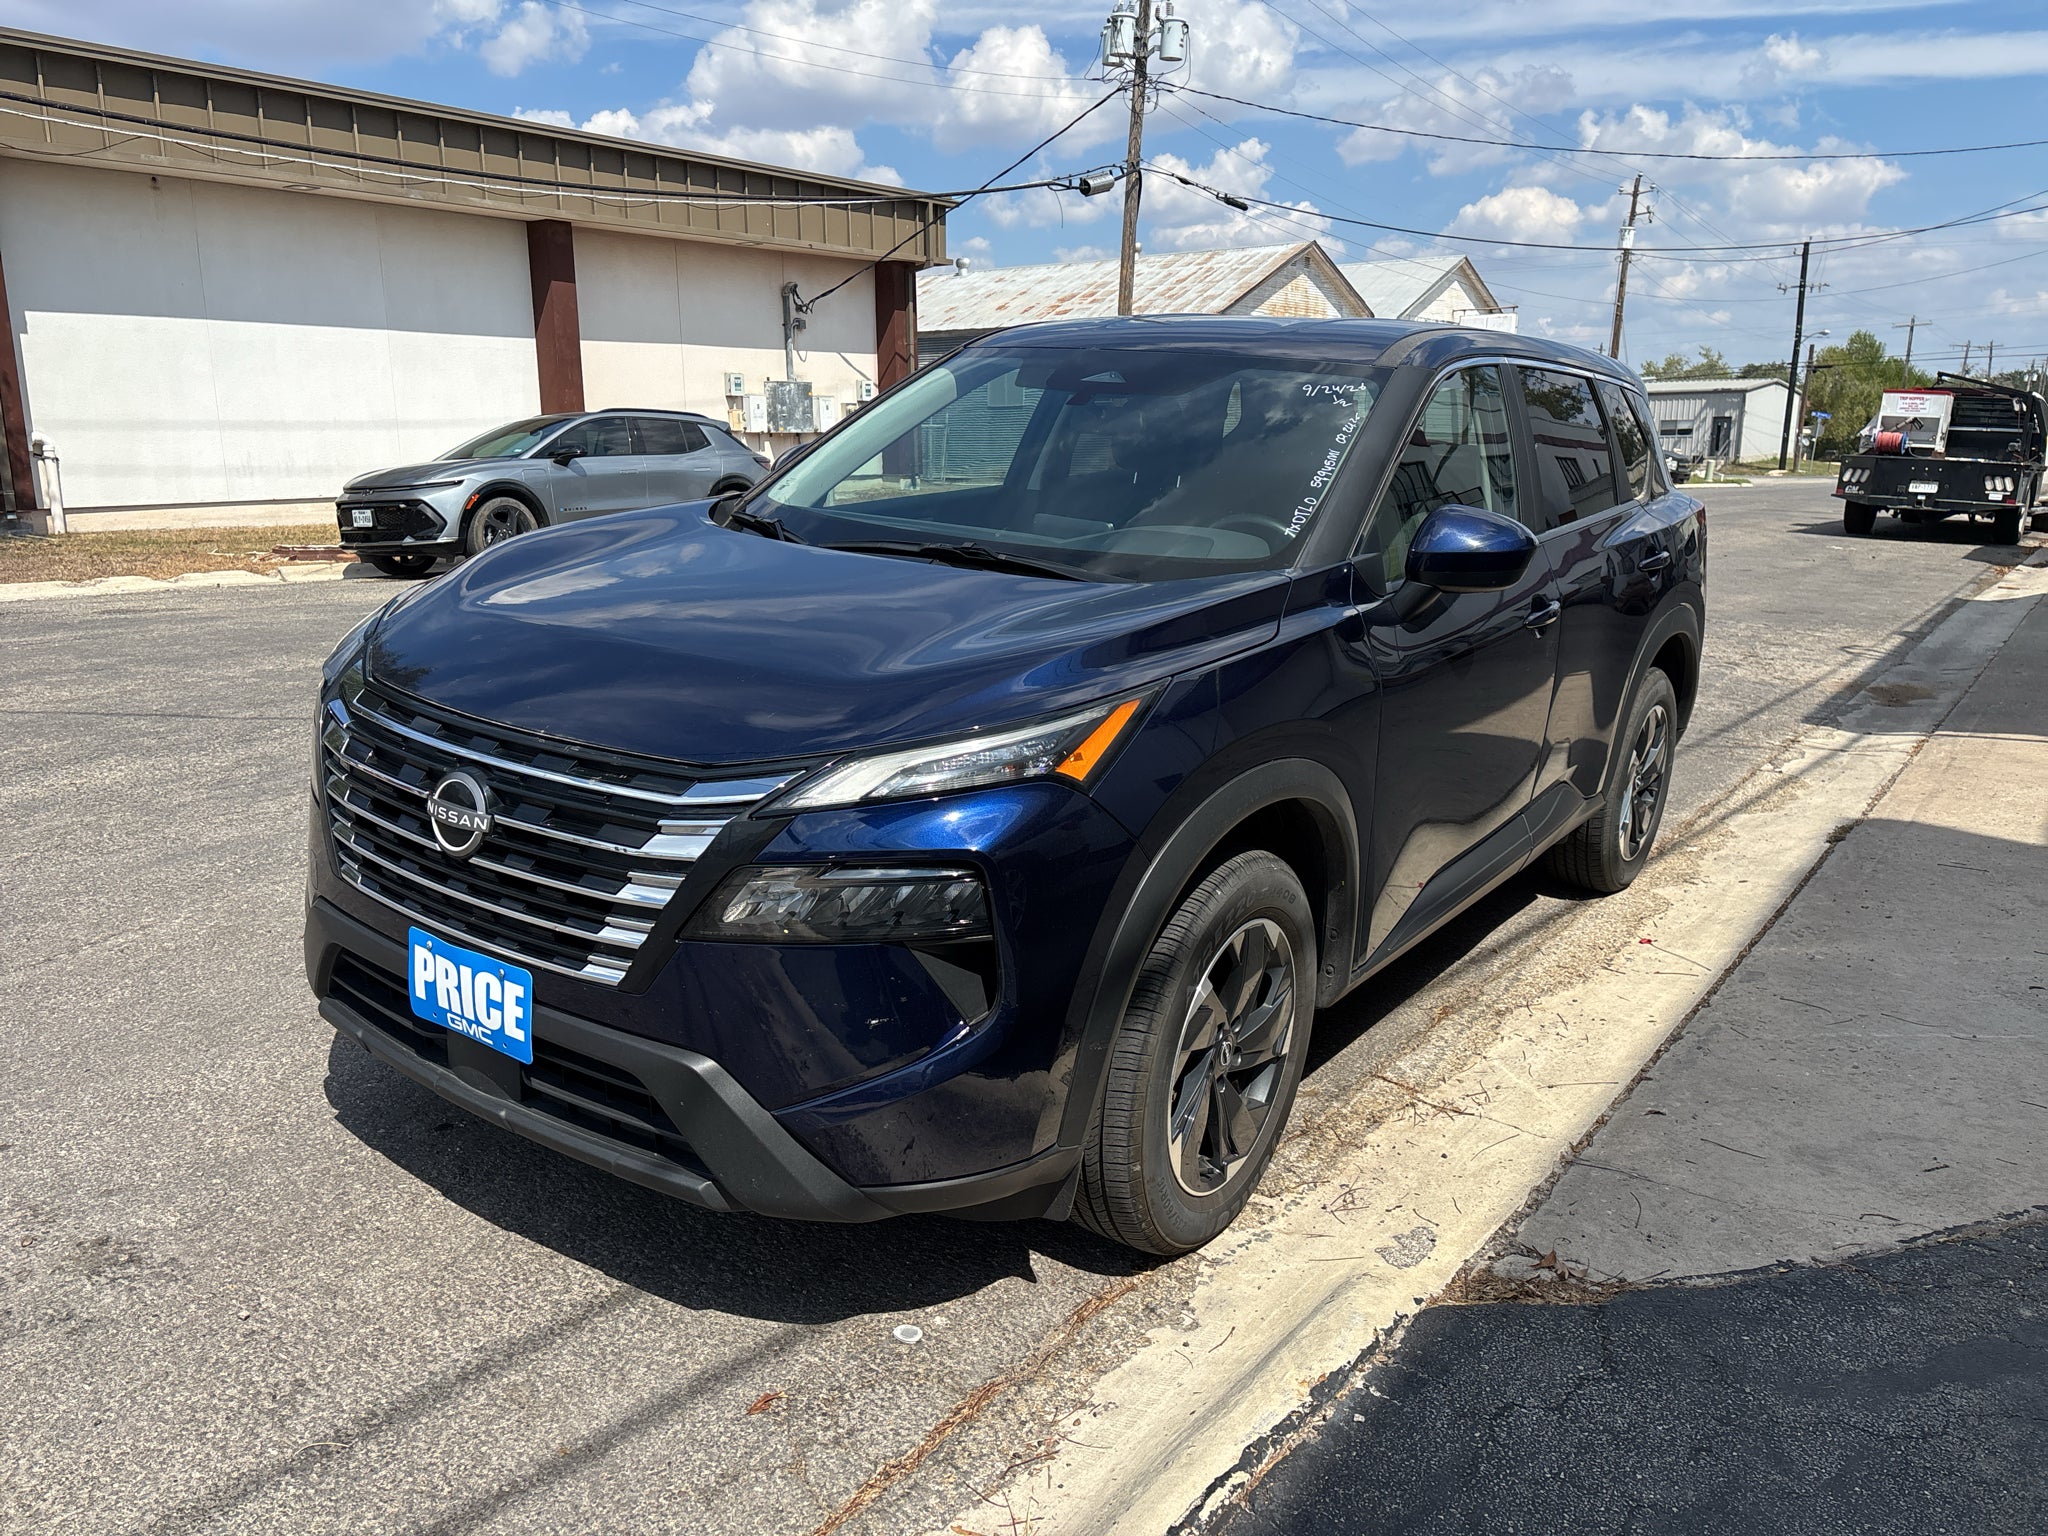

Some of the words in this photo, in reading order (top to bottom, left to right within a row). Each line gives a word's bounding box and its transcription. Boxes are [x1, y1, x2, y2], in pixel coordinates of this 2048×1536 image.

[427, 799, 488, 831] NISSAN
[414, 943, 526, 1042] PRICE
[446, 1012, 494, 1046] GMC
